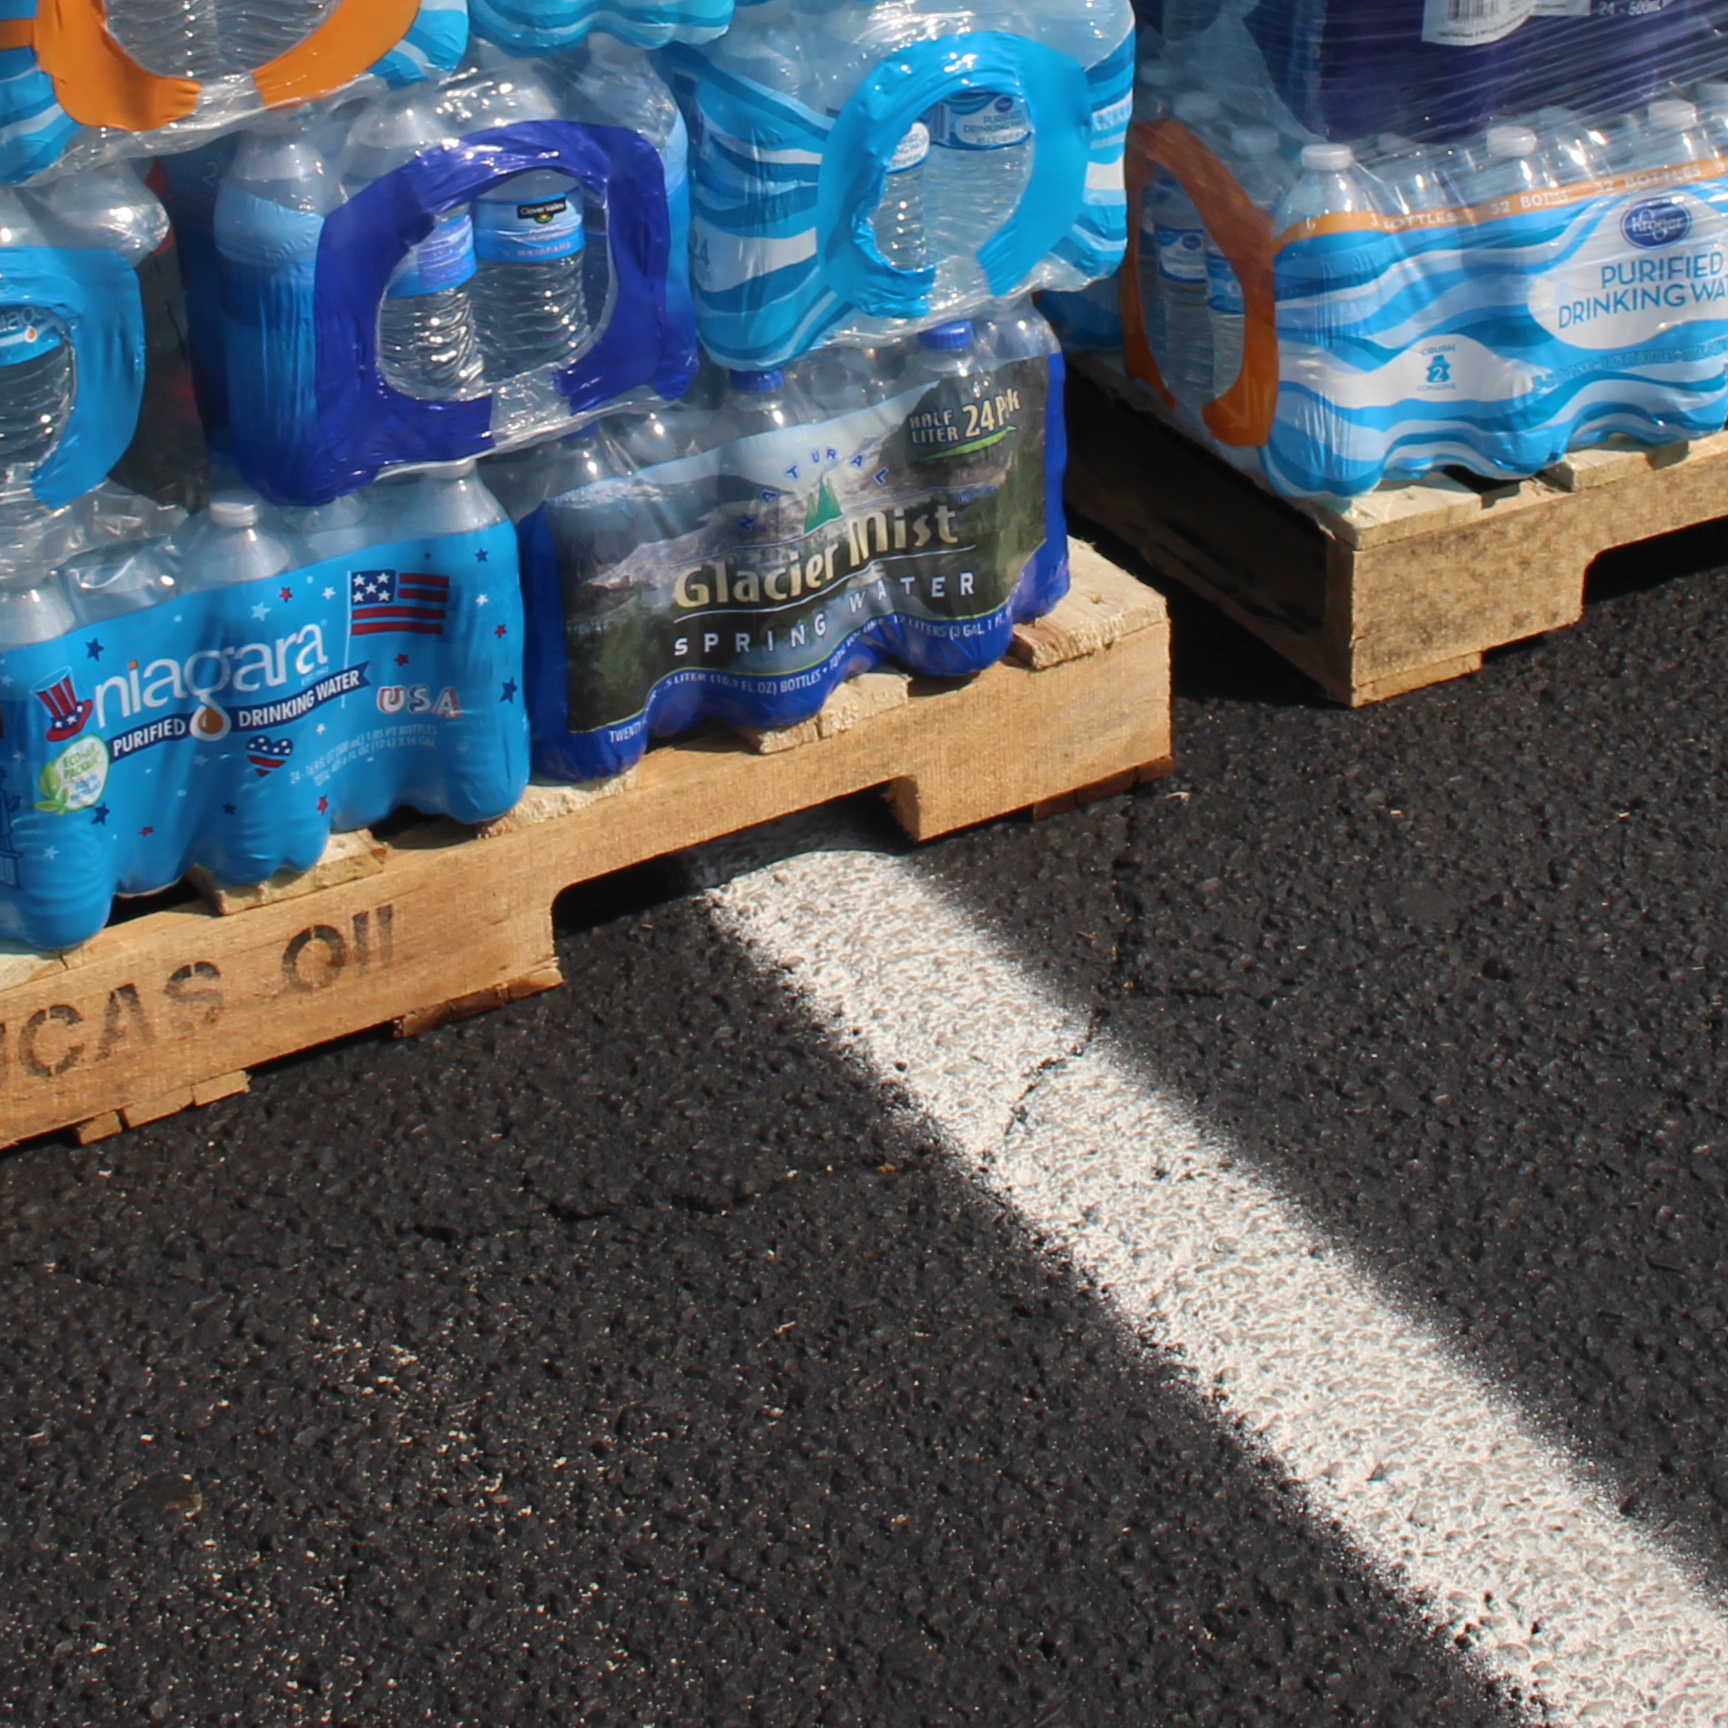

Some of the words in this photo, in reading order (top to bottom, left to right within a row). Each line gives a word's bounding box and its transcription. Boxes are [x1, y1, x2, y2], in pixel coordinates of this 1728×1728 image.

[1624, 162, 1703, 190] BOTTLES
[1490, 198, 1513, 218] 32
[1629, 202, 1689, 250] Kroger
[1599, 251, 1724, 290] PURIFIED
[1558, 284, 1690, 331] DRINKING
[1431, 364, 1445, 382] 2
[908, 408, 954, 429] HALF
[962, 403, 996, 440] 24
[910, 425, 959, 444] LITER
[673, 539, 841, 610] Glacier
[848, 503, 960, 569] Mist
[673, 608, 828, 658] SPRING
[848, 571, 977, 616] WATER
[94, 623, 329, 730] niagara
[779, 670, 822, 695] BOTTLES
[112, 717, 187, 757] PURIFIED
[237, 692, 315, 730] DRINKING
[314, 667, 362, 704] WATER
[376, 685, 461, 718] USA
